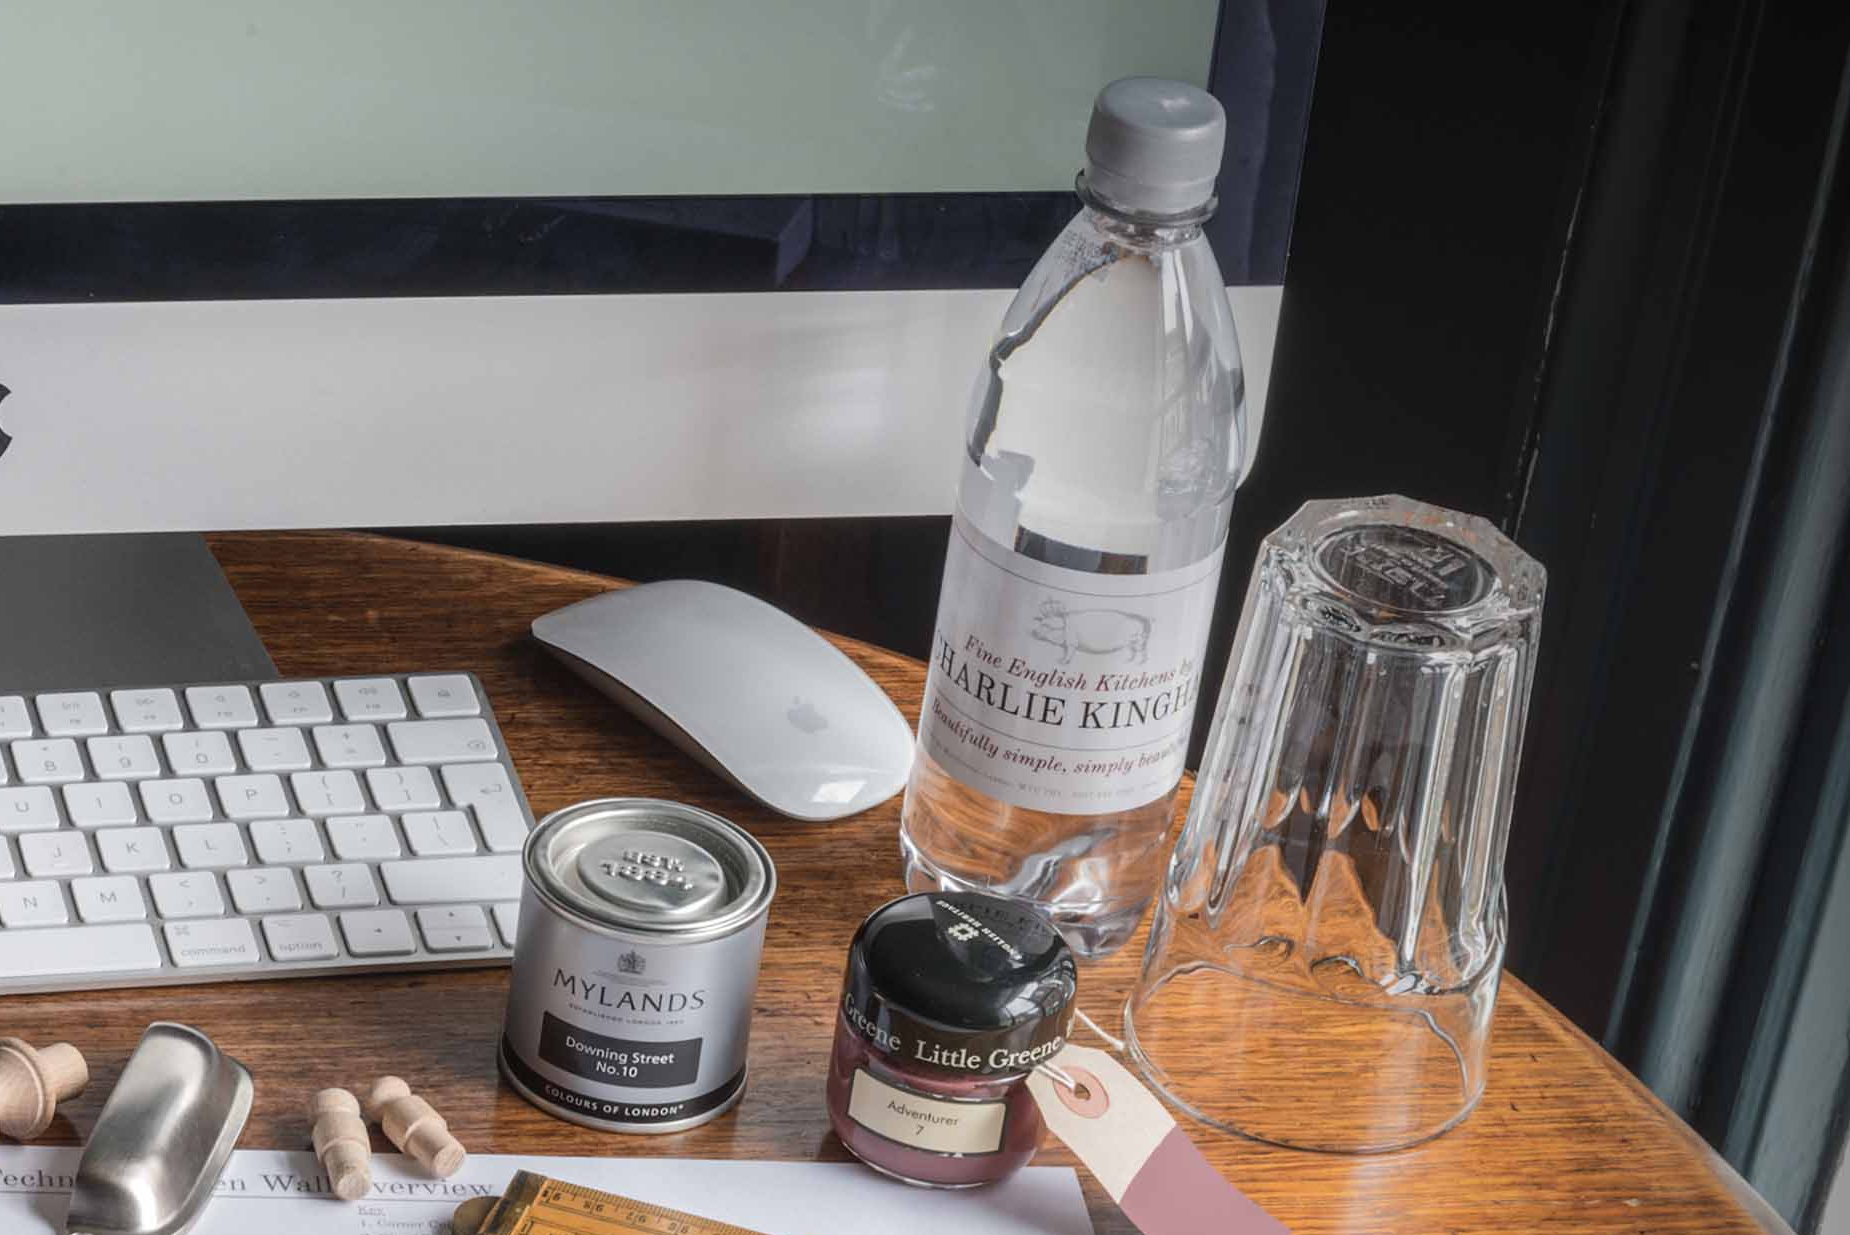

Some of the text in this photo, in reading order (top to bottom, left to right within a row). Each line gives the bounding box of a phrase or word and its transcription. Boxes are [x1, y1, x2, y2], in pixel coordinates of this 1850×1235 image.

[964, 633, 1175, 693] Fine English Kitchens
[1078, 673, 1198, 729] KINGH
[1002, 747, 1068, 775] simple,
[1073, 757, 1135, 777] simply
[16, 800, 29, 813] U
[125, 841, 138, 853] K
[23, 896, 38, 909] N
[99, 891, 118, 904] M
[180, 944, 247, 957] command
[553, 967, 706, 1014] MYLANDS
[844, 992, 1062, 1070] Greene Little Greene
[565, 1034, 675, 1065] Downing Street
[596, 1060, 639, 1079] No.10
[544, 1082, 598, 1112] COLOURS
[603, 1104, 620, 1116] OF
[886, 1099, 959, 1127] Adventurer
[916, 1124, 925, 1136] 7
[370, 1179, 495, 1196] verview
